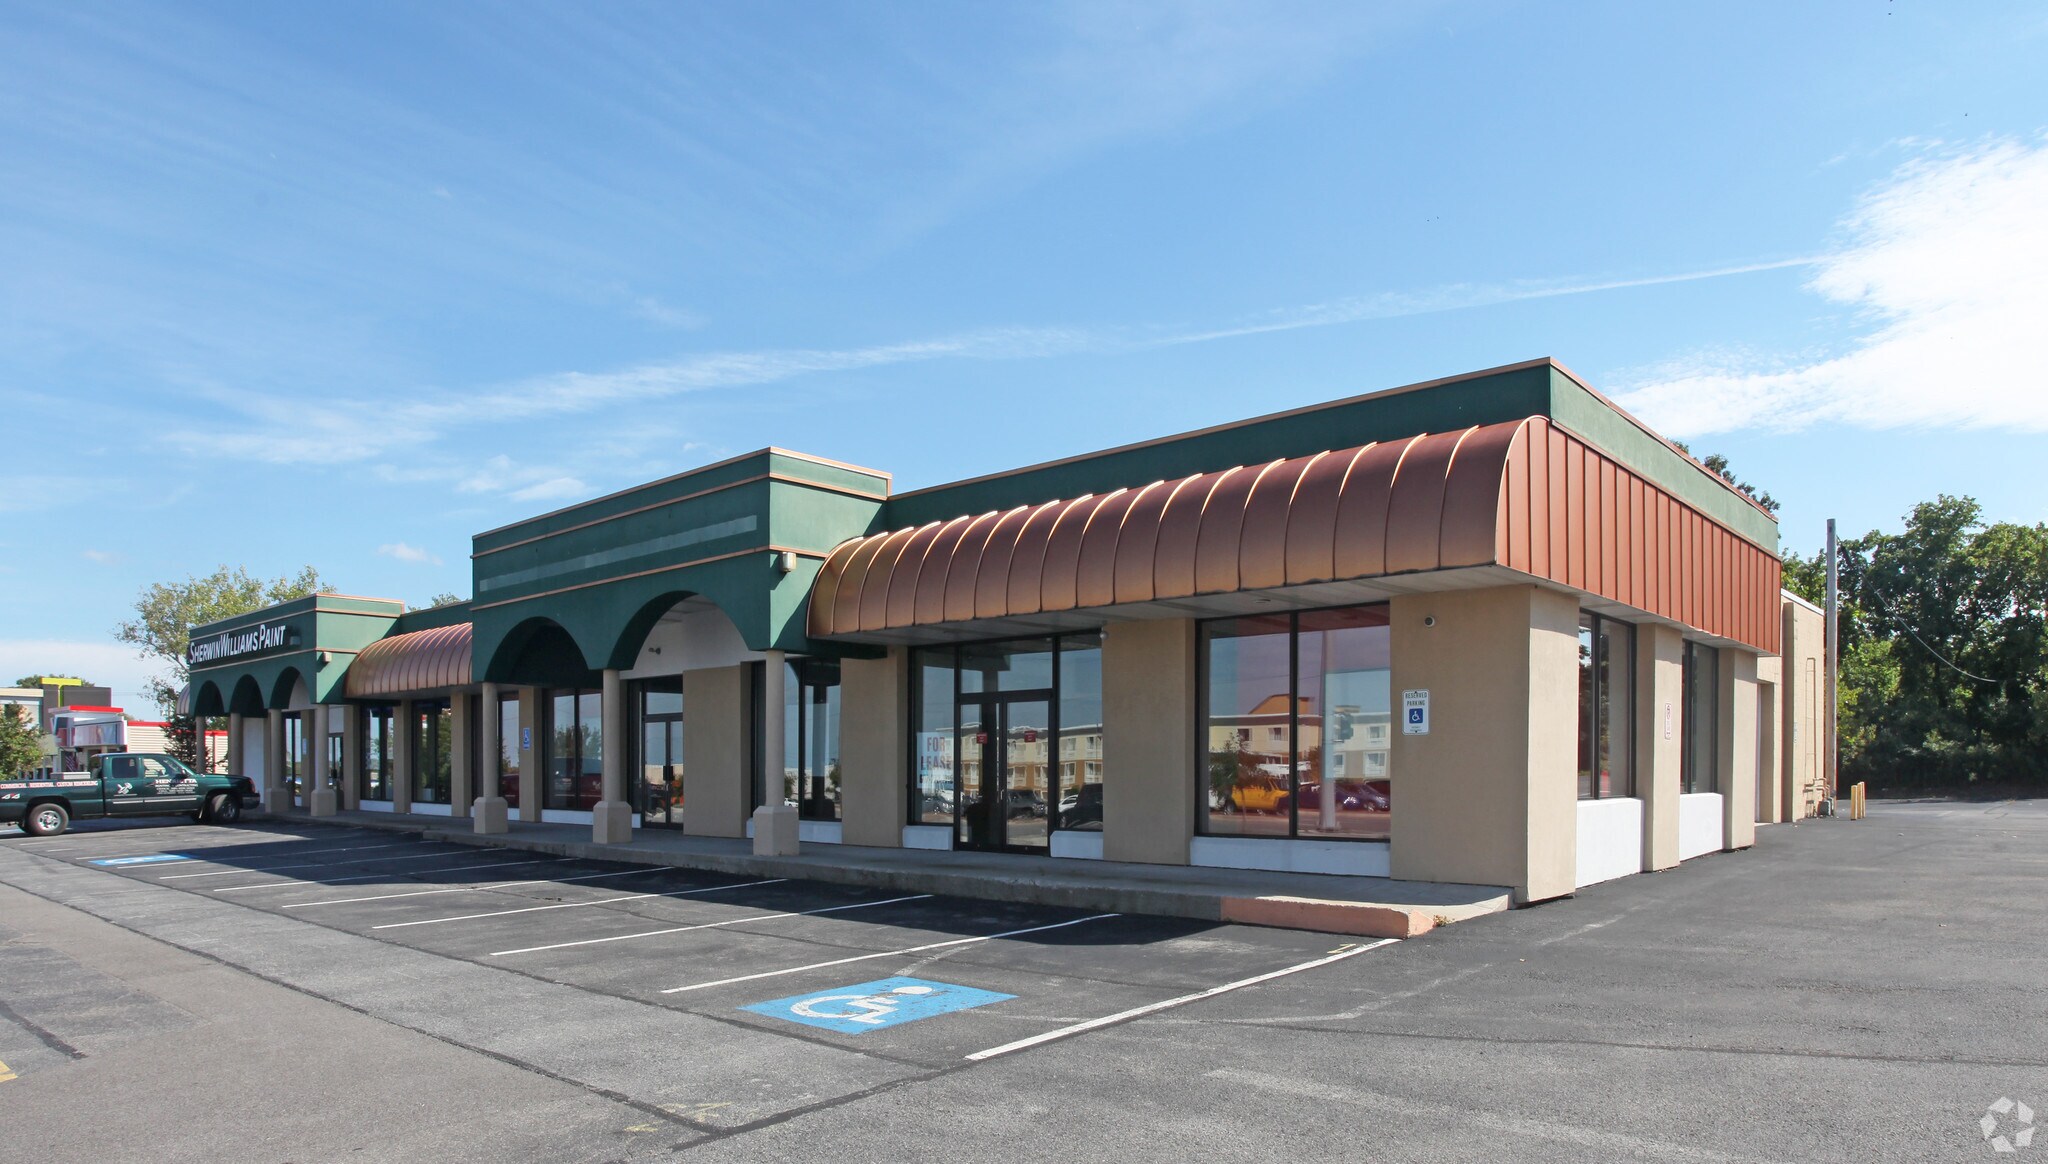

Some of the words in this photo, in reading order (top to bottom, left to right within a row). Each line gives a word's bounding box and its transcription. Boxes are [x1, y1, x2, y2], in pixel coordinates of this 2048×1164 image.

[259, 624, 286, 650] PAINT
[927, 737, 945, 752] FOR
[921, 756, 952, 770] LEASE
